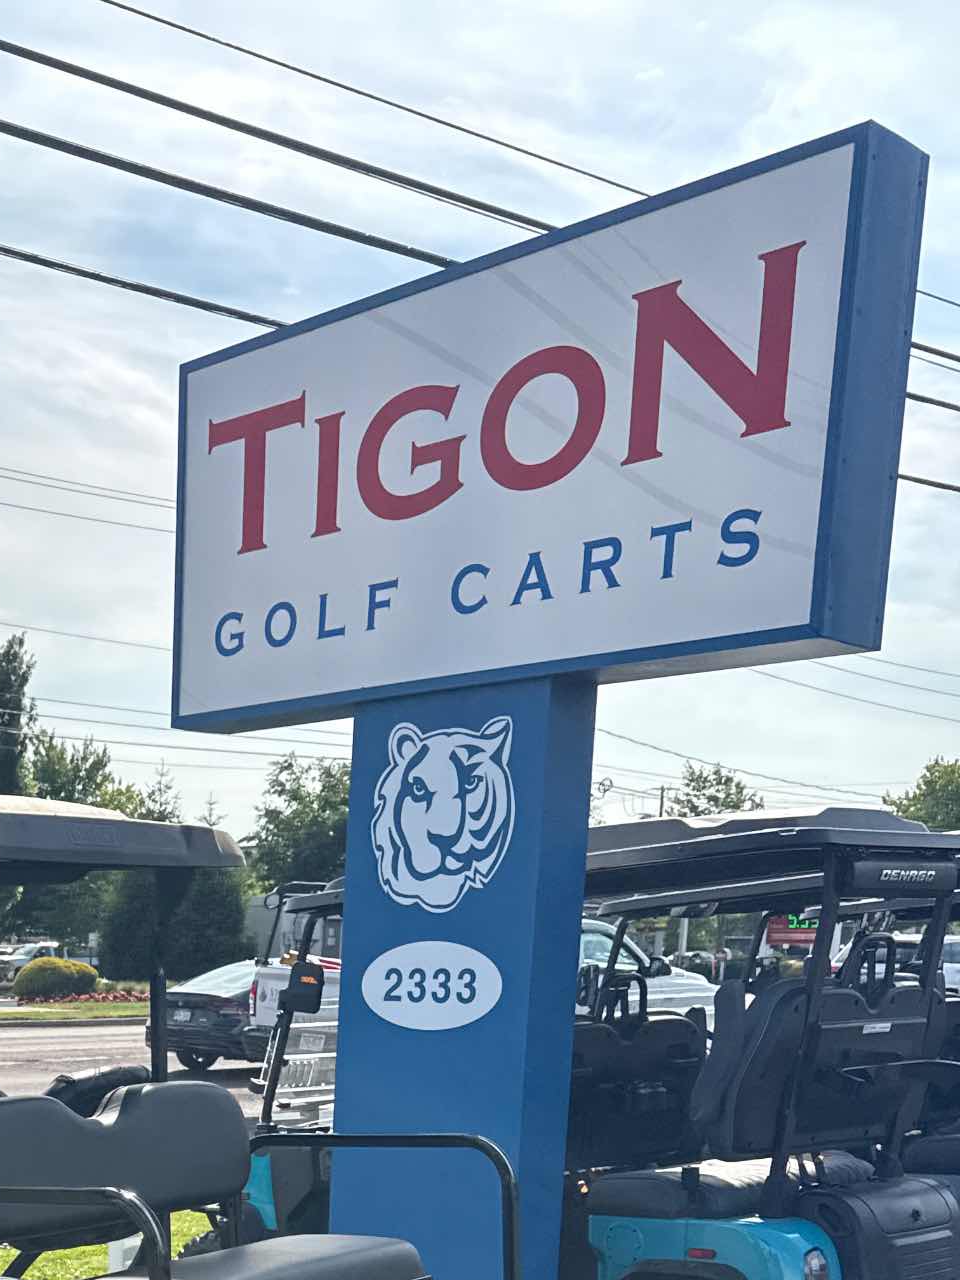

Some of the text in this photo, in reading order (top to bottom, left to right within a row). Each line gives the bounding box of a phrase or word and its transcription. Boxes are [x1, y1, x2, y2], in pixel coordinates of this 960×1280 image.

[208, 239, 807, 556] TIGON
[214, 508, 763, 658] GOLF CARTS
[880, 869, 936, 881] DENAGO
[383, 967, 477, 1004] 2333
